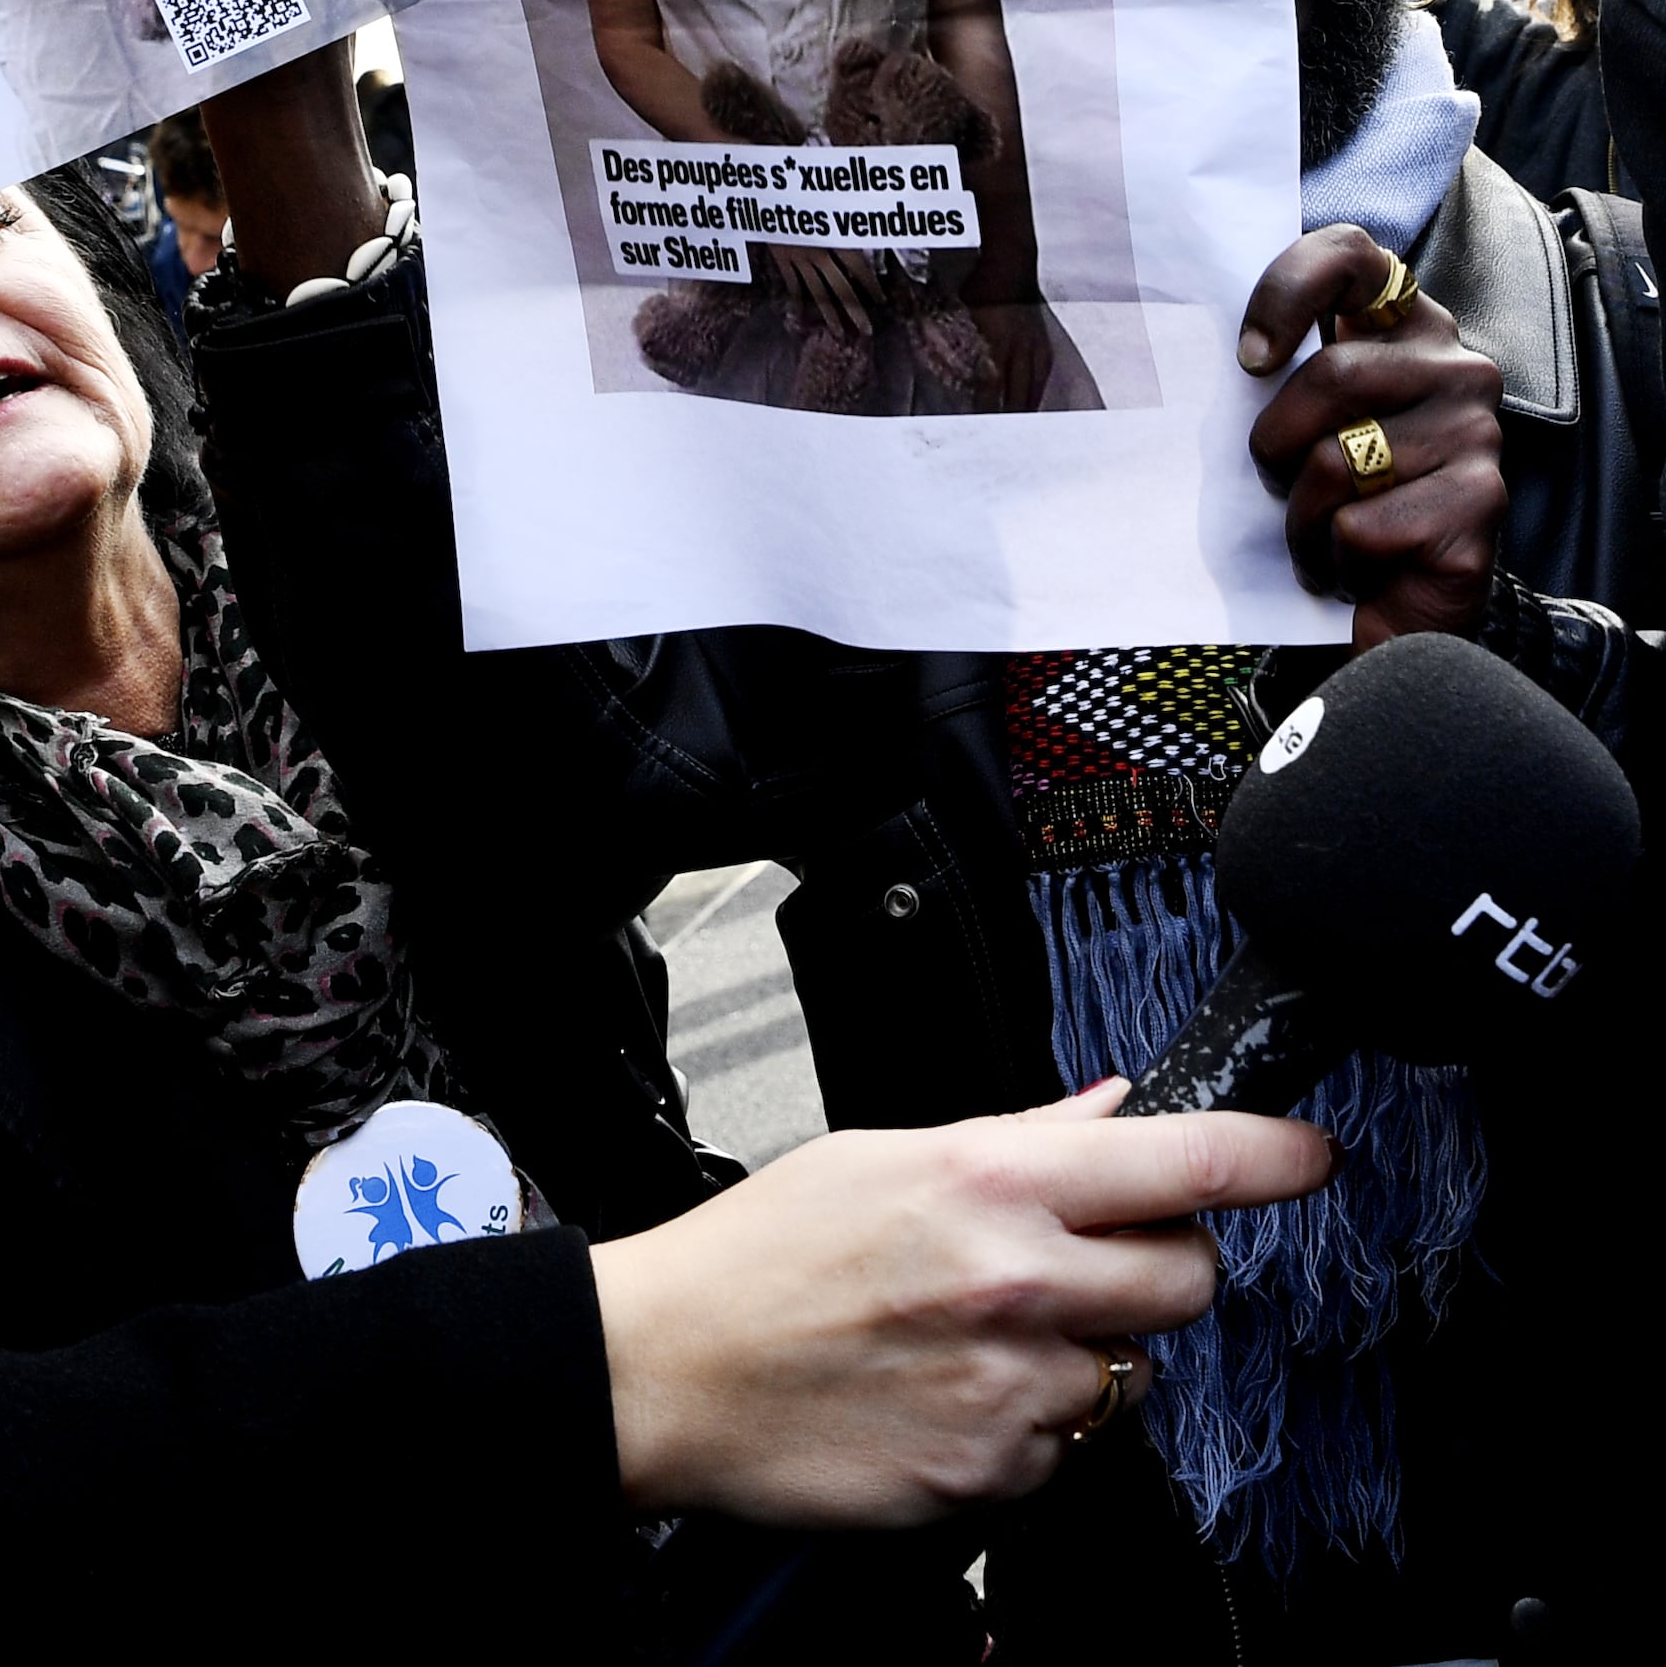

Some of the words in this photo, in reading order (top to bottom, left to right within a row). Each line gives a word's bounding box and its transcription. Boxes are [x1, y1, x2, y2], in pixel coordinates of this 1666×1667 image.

[602, 149, 654, 185] Des
[658, 153, 767, 193] poupées
[910, 164, 949, 191] en
[610, 191, 688, 229] forme
[691, 197, 725, 230] de
[725, 196, 830, 235] fillettes
[833, 202, 965, 237] vendues
[621, 242, 660, 267] sur
[663, 238, 739, 273] Shein
